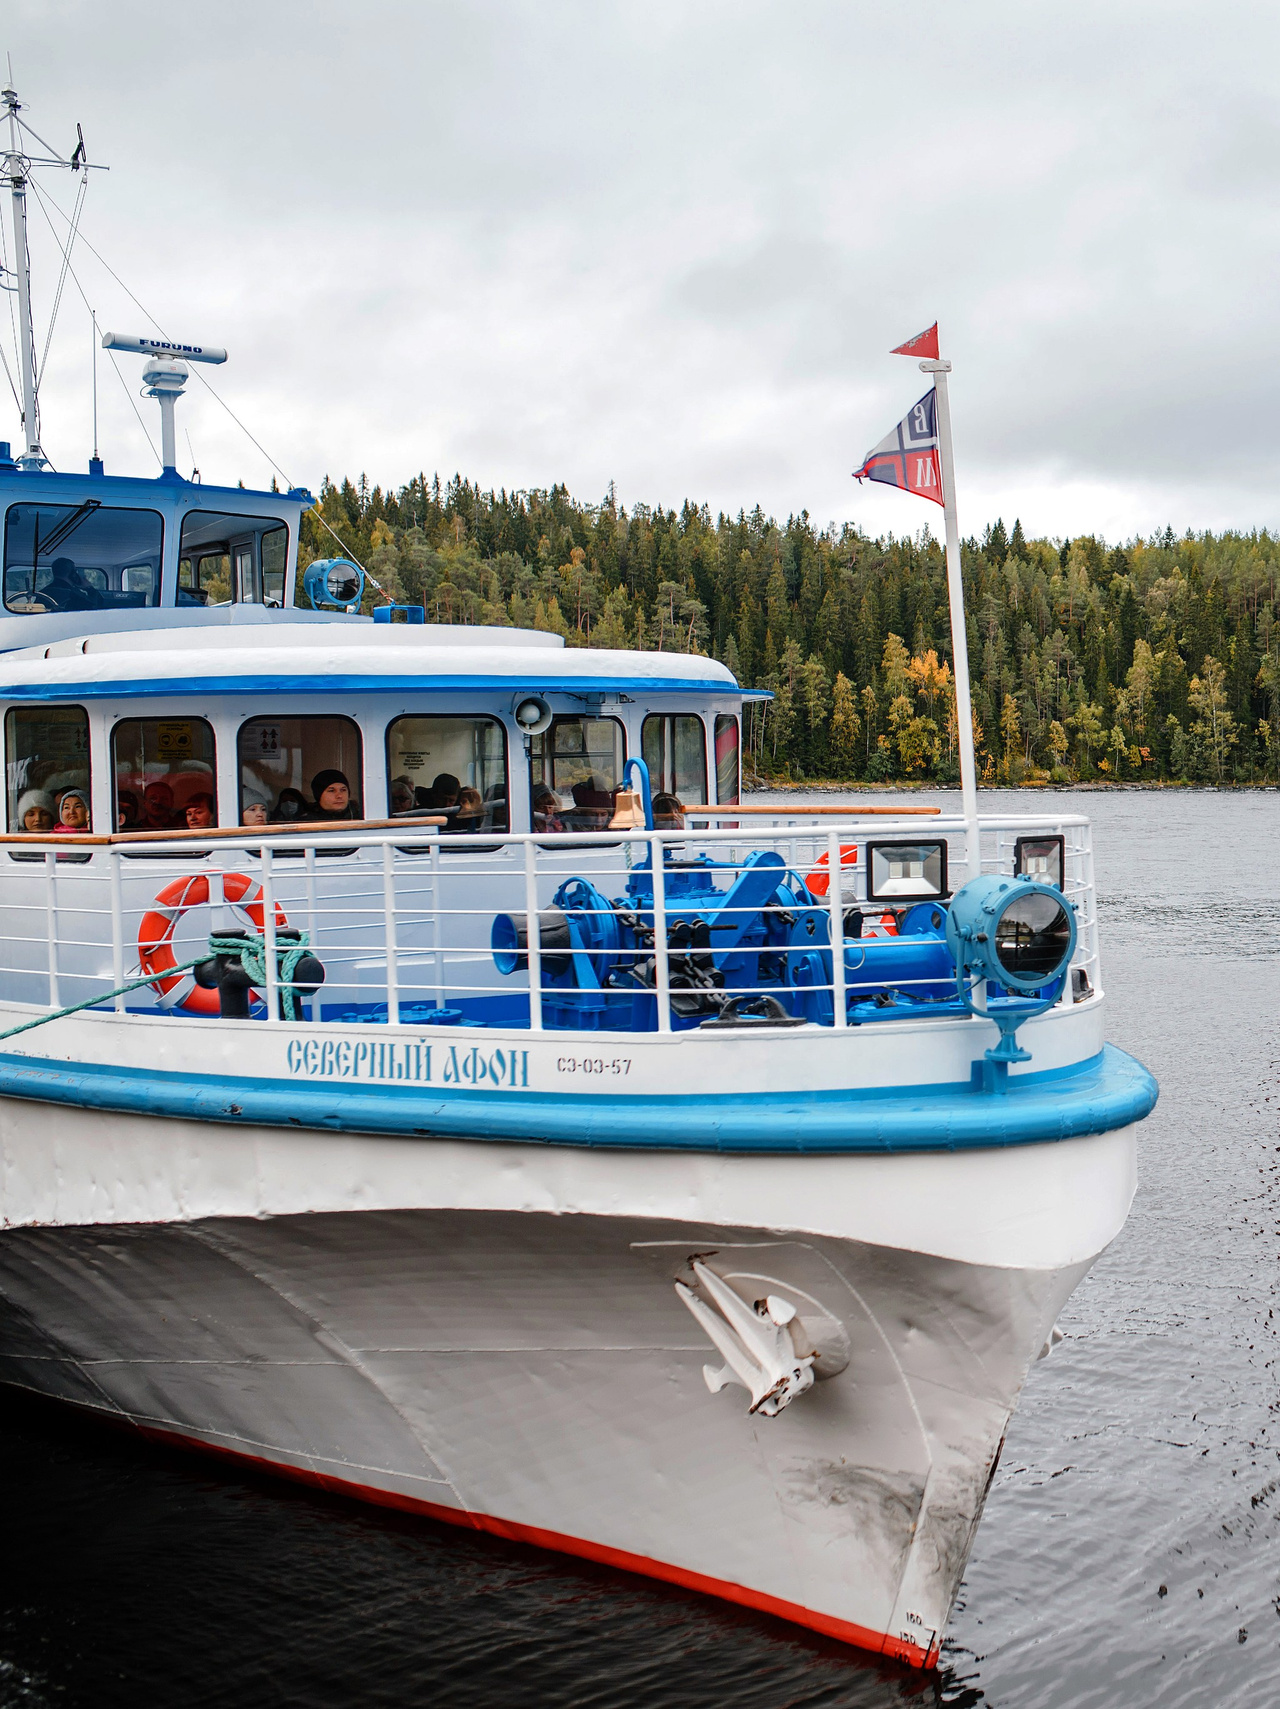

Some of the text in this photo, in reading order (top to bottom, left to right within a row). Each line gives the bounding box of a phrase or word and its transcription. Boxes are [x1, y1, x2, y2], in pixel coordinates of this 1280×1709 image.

[139, 338, 203, 354] FURUNO
[286, 1038, 530, 1087] СЕВЕРНЫЙ АФОН
[906, 1611, 922, 1625] 160
